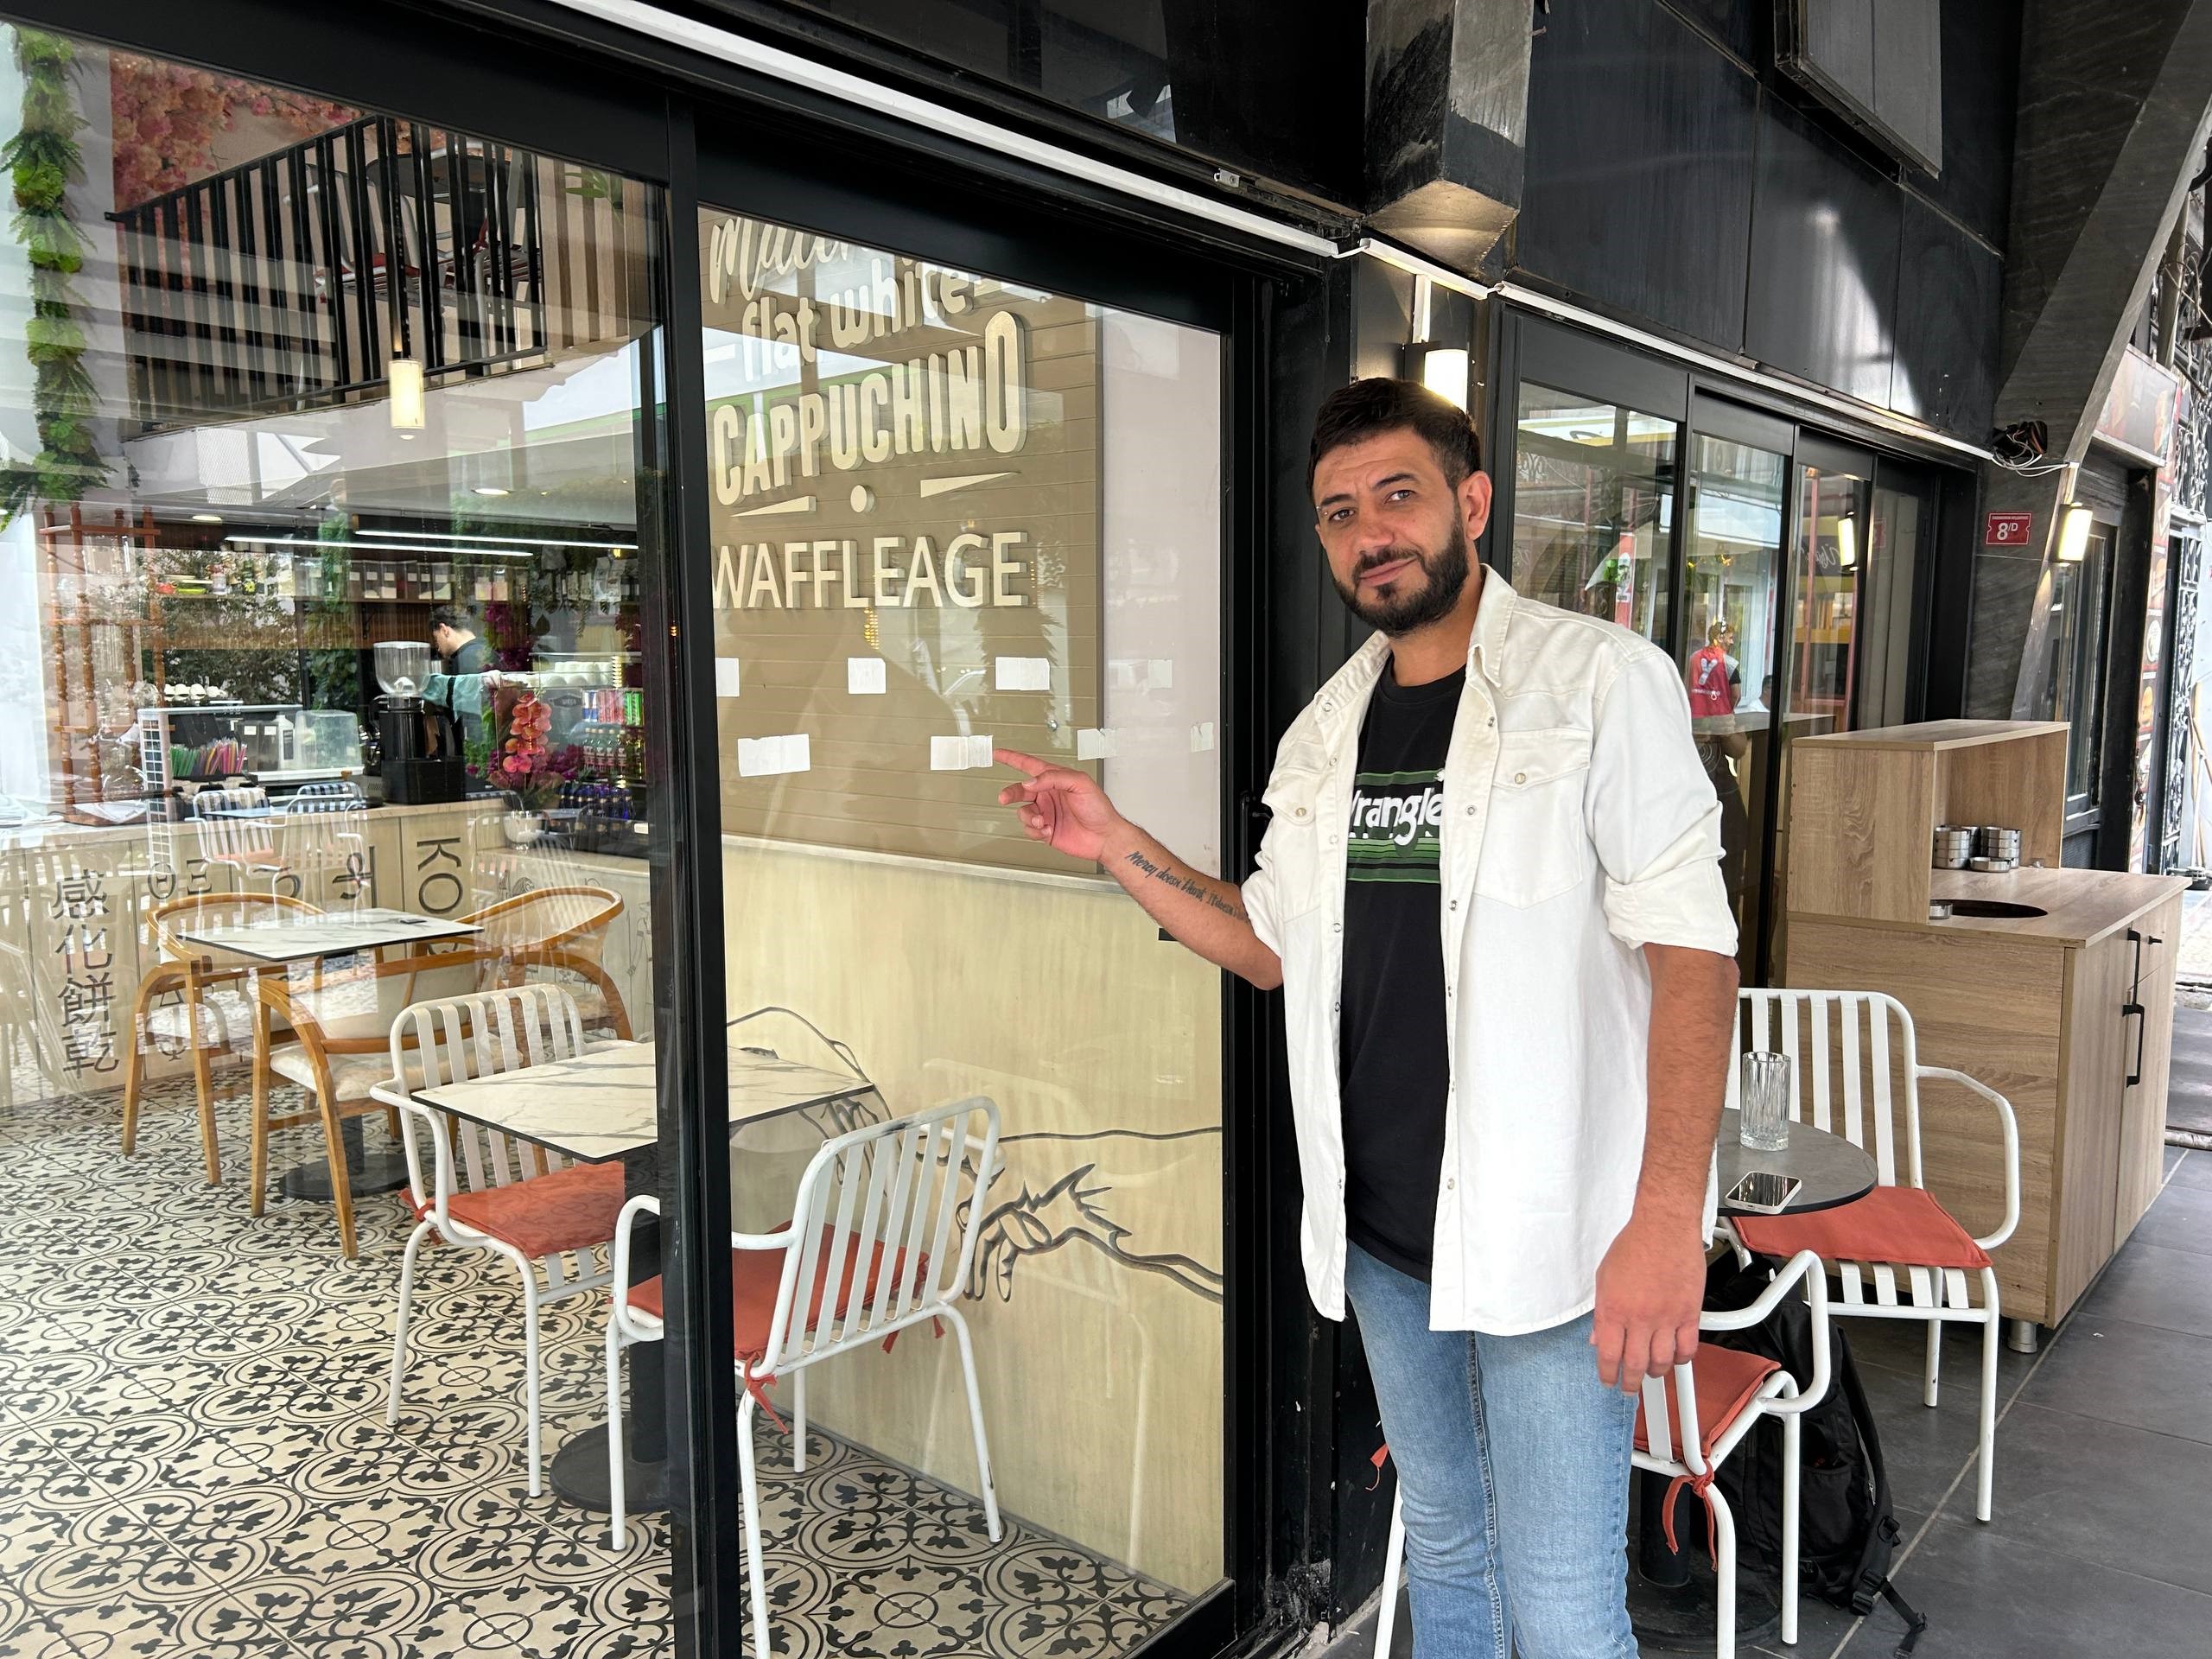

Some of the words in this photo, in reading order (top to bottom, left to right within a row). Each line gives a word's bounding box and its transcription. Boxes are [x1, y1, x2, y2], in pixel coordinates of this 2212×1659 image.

[741, 296, 817, 382] flat
[830, 257, 970, 348] white
[713, 310, 1026, 506] CAPPUCHINO
[712, 531, 1027, 609] WAFFLEAGE
[1349, 787, 1443, 846] rangle
